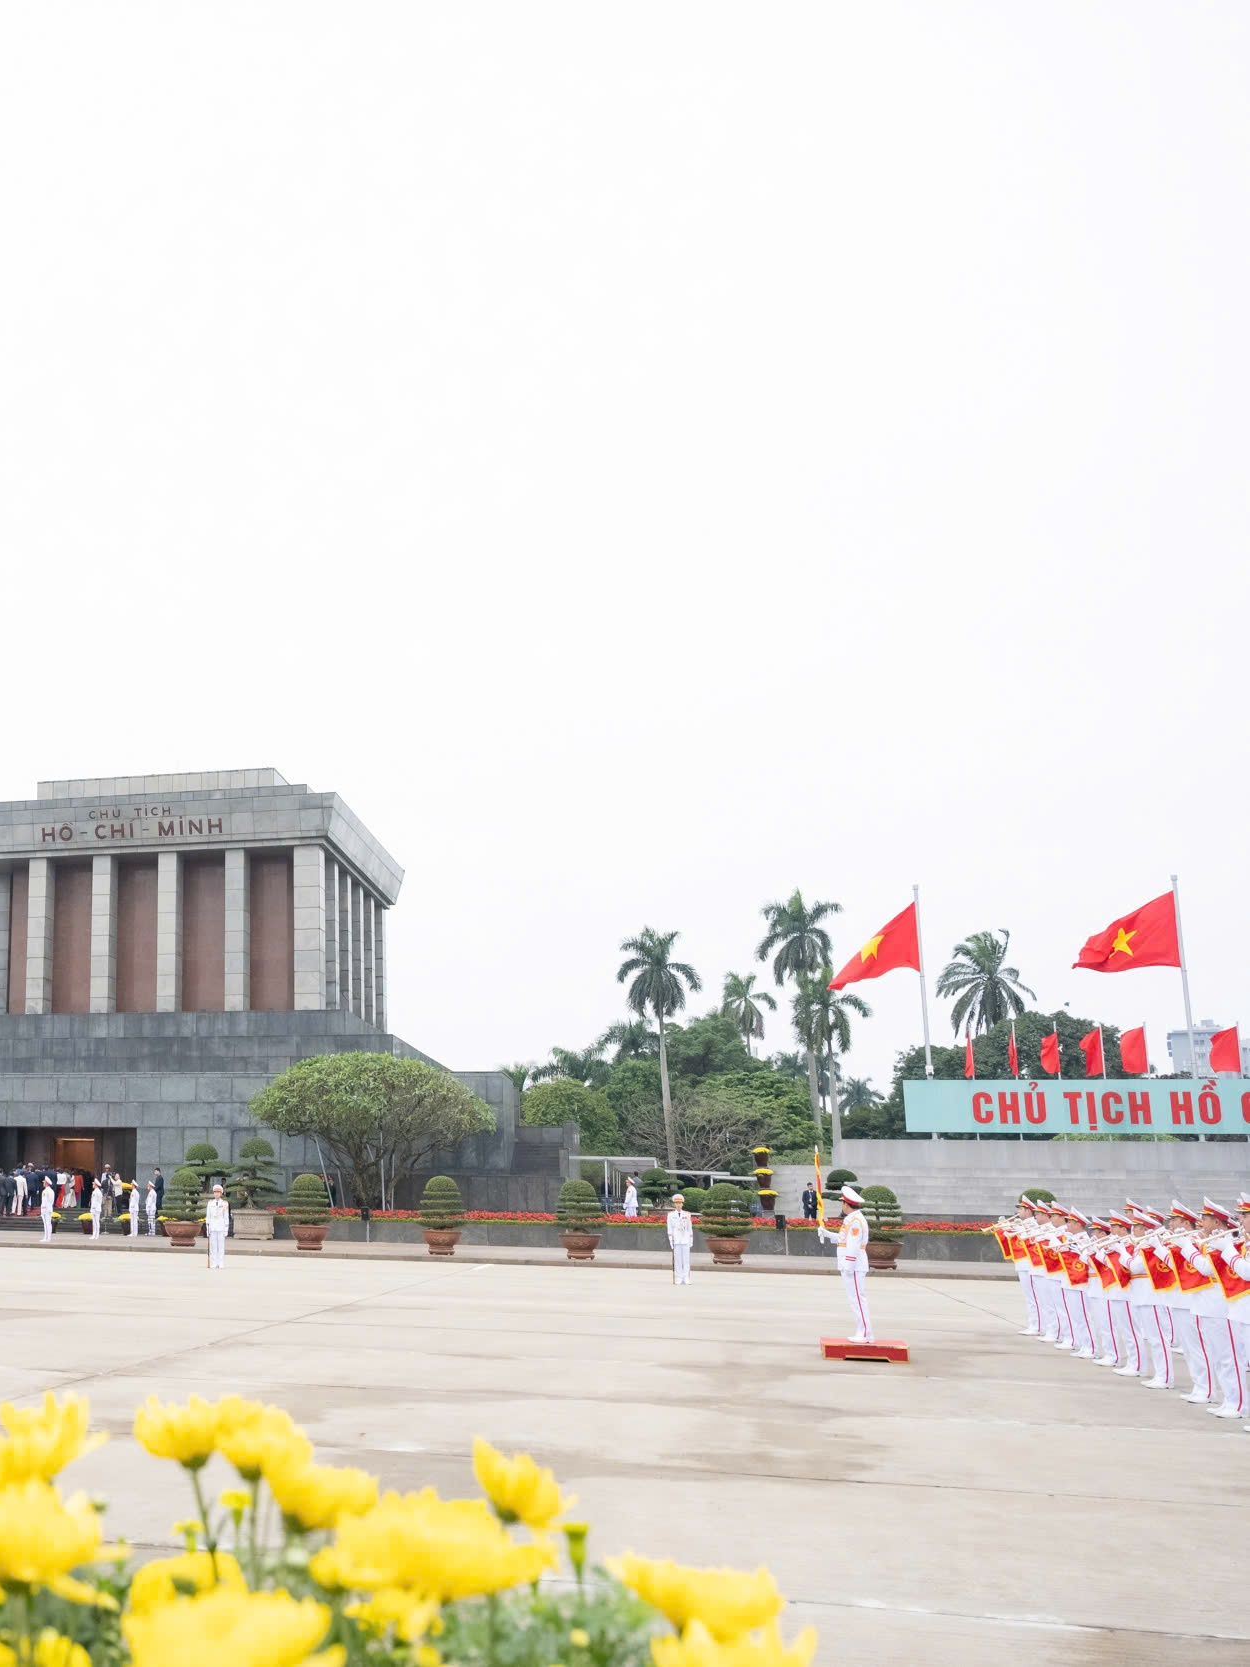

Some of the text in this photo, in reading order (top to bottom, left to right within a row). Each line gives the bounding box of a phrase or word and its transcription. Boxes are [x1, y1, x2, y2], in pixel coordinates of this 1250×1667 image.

[41, 822, 74, 842] HỒ
[94, 818, 135, 840] CHÍ
[971, 1081, 1047, 1125] CHỦ
[1063, 1091, 1153, 1131] TỊCH
[1169, 1080, 1222, 1125] HỒ
